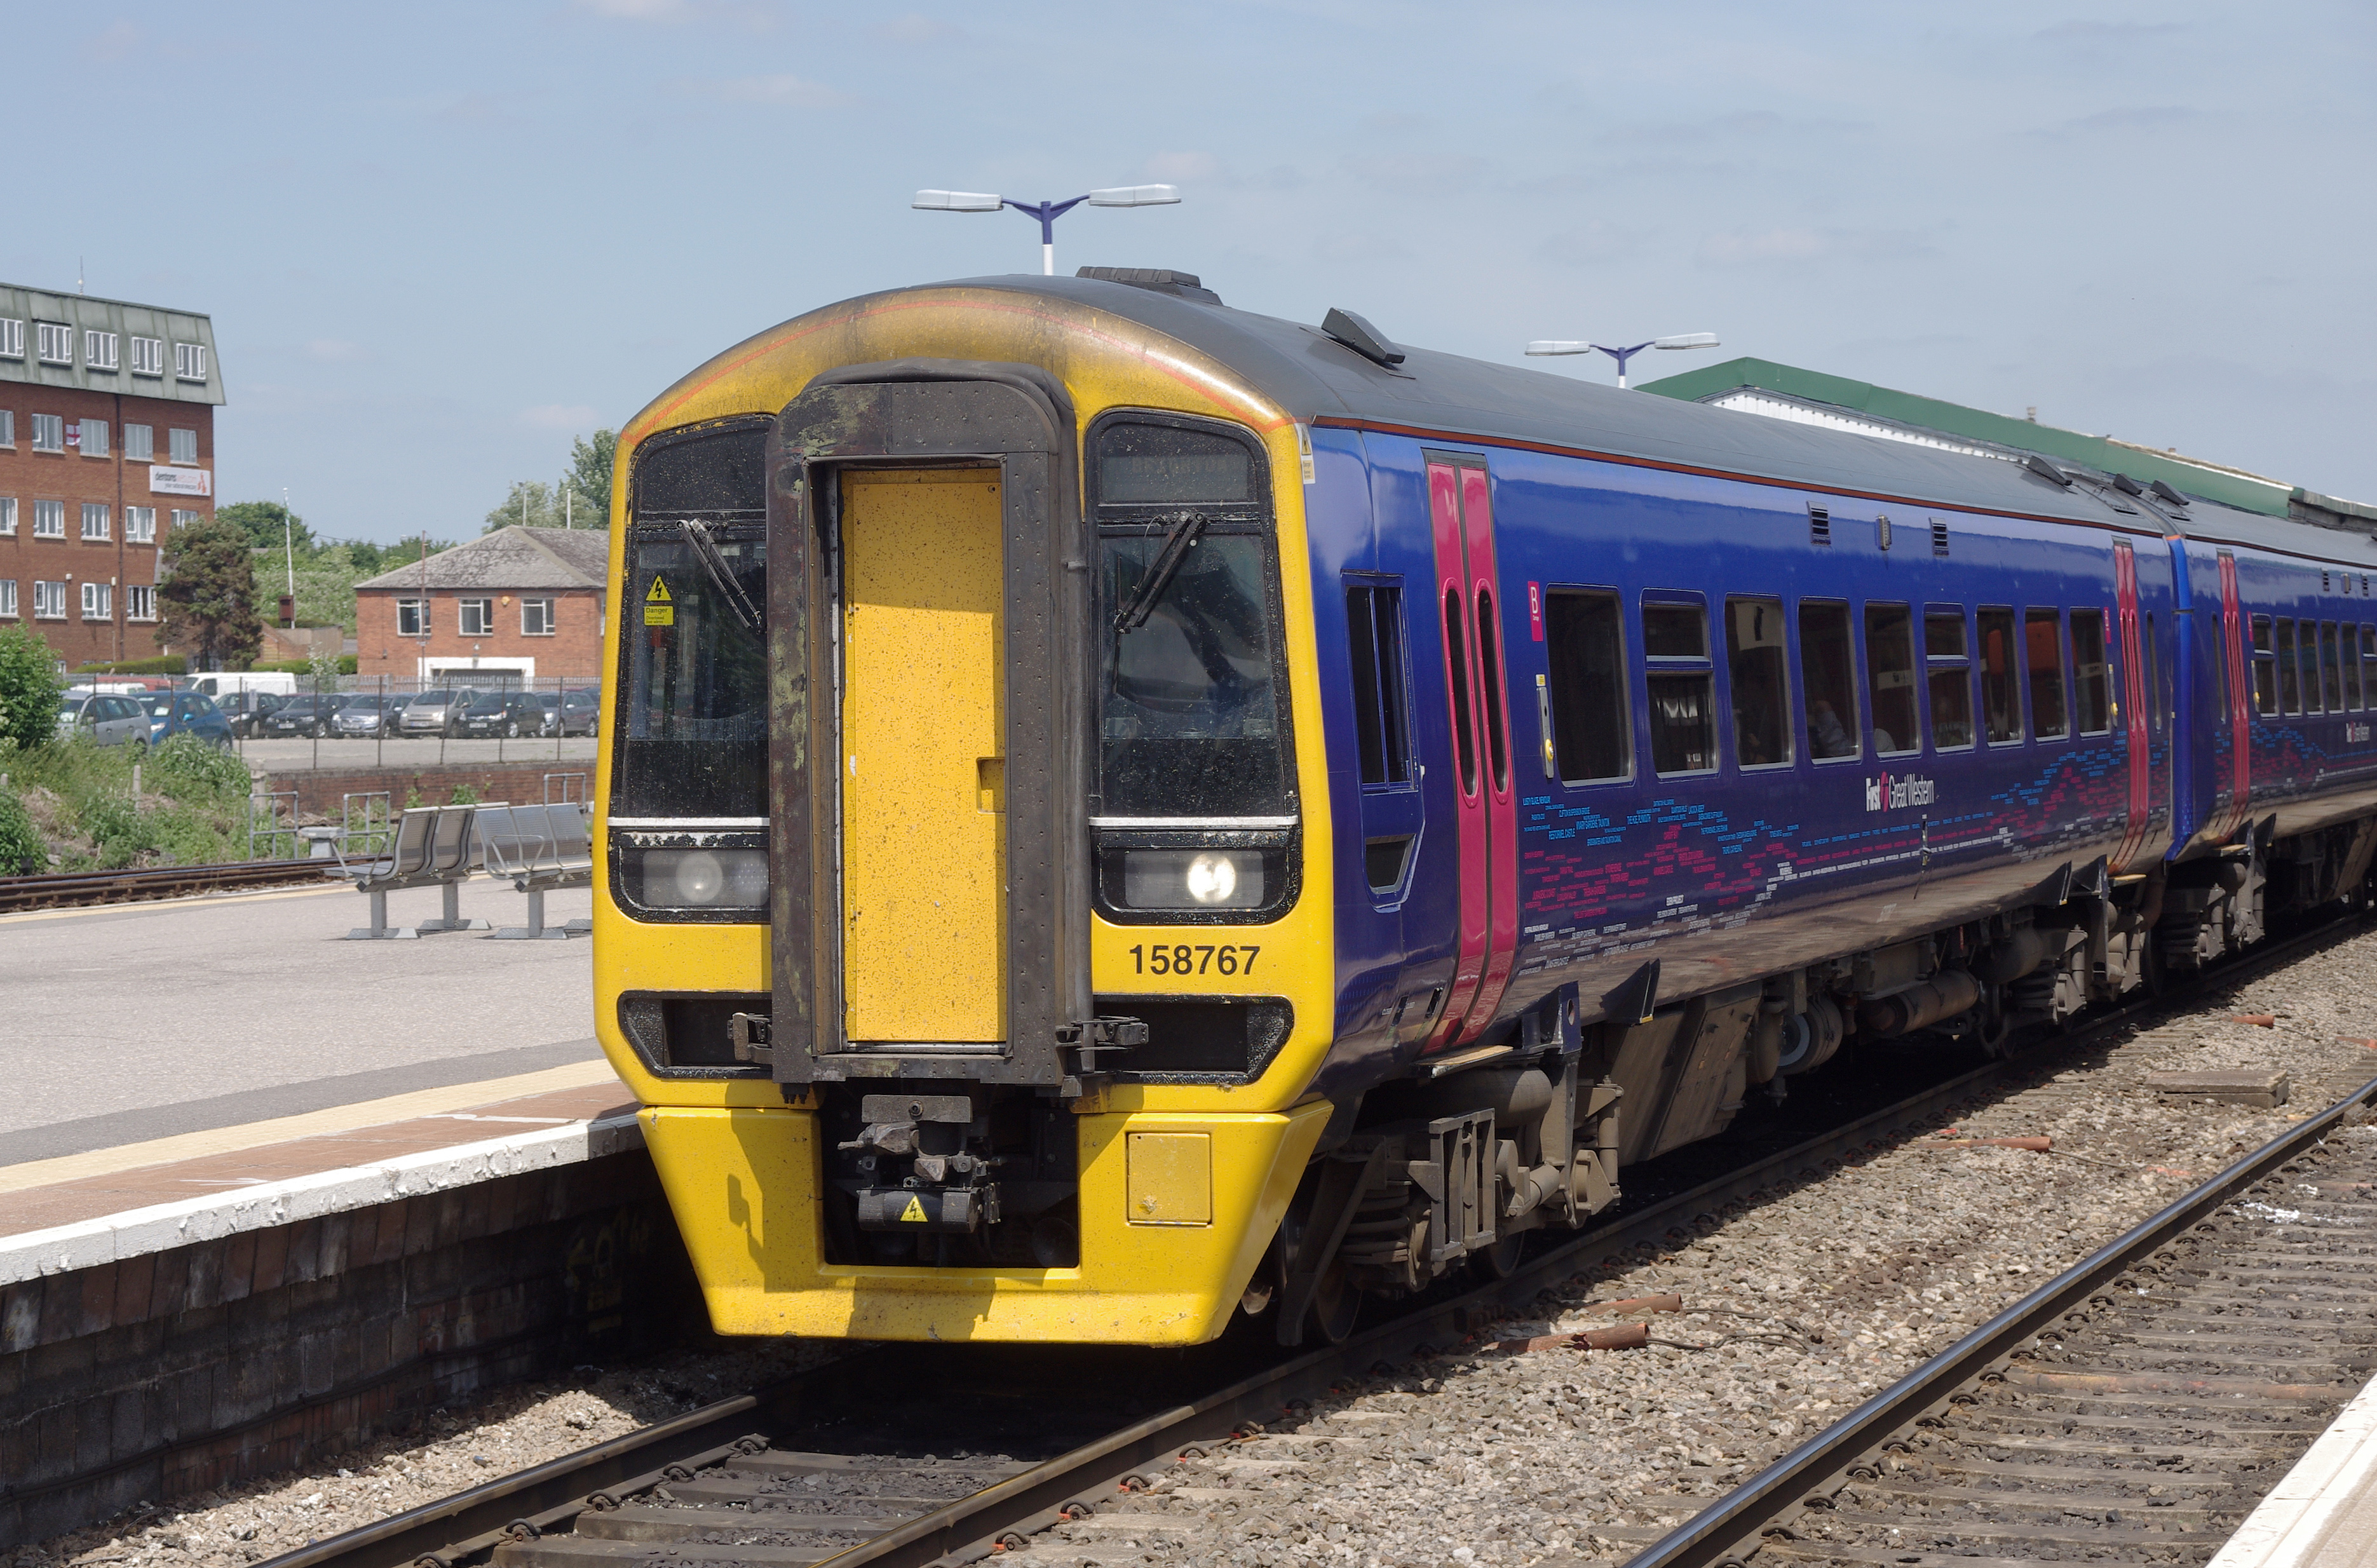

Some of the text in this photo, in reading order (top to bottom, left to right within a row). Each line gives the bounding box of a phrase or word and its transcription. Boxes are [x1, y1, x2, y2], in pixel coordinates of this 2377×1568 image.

[1530, 586, 1538, 614] B
[1866, 773, 1934, 812] First Great Western
[1129, 944, 1261, 976] 158767
